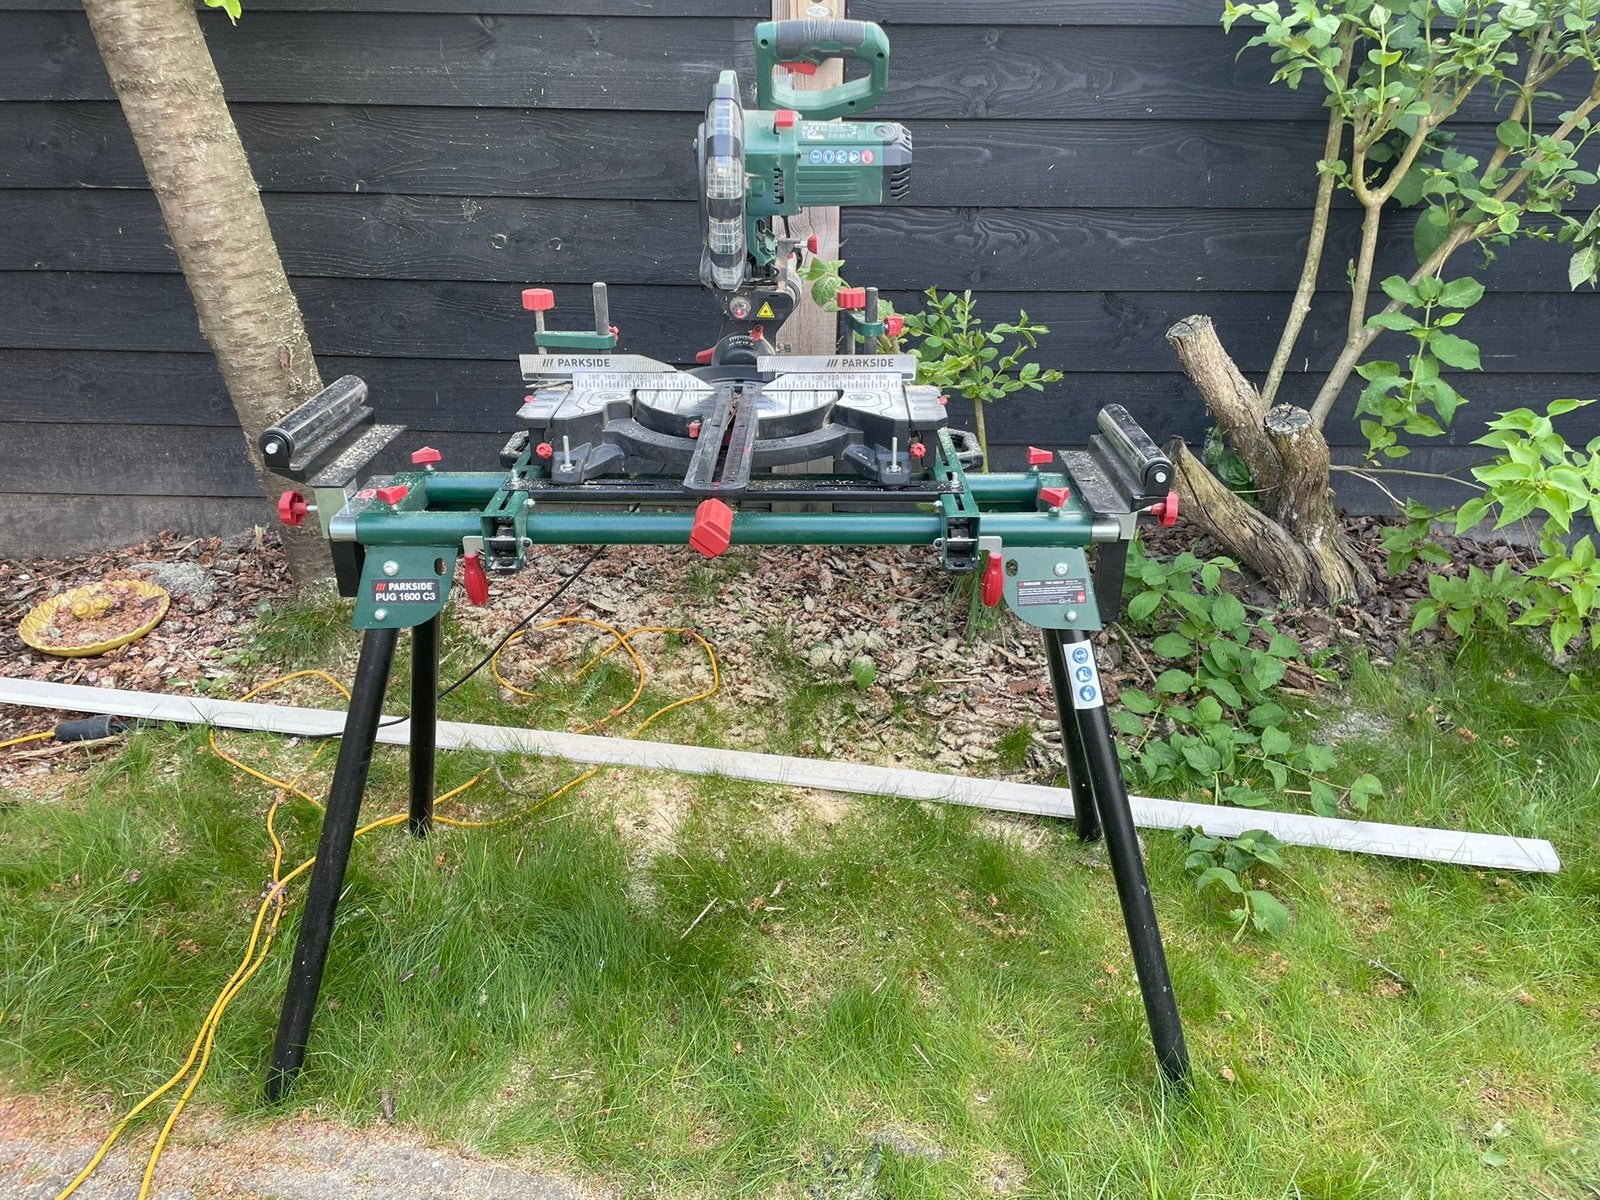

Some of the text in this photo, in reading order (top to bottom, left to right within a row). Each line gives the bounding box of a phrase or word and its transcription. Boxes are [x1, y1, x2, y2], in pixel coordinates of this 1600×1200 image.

[559, 358, 610, 367] PARKSIDE
[842, 358, 894, 367] PARKSIDE
[388, 582, 433, 591] PARKSIDE
[375, 592, 435, 601] PUG 1600 C3
